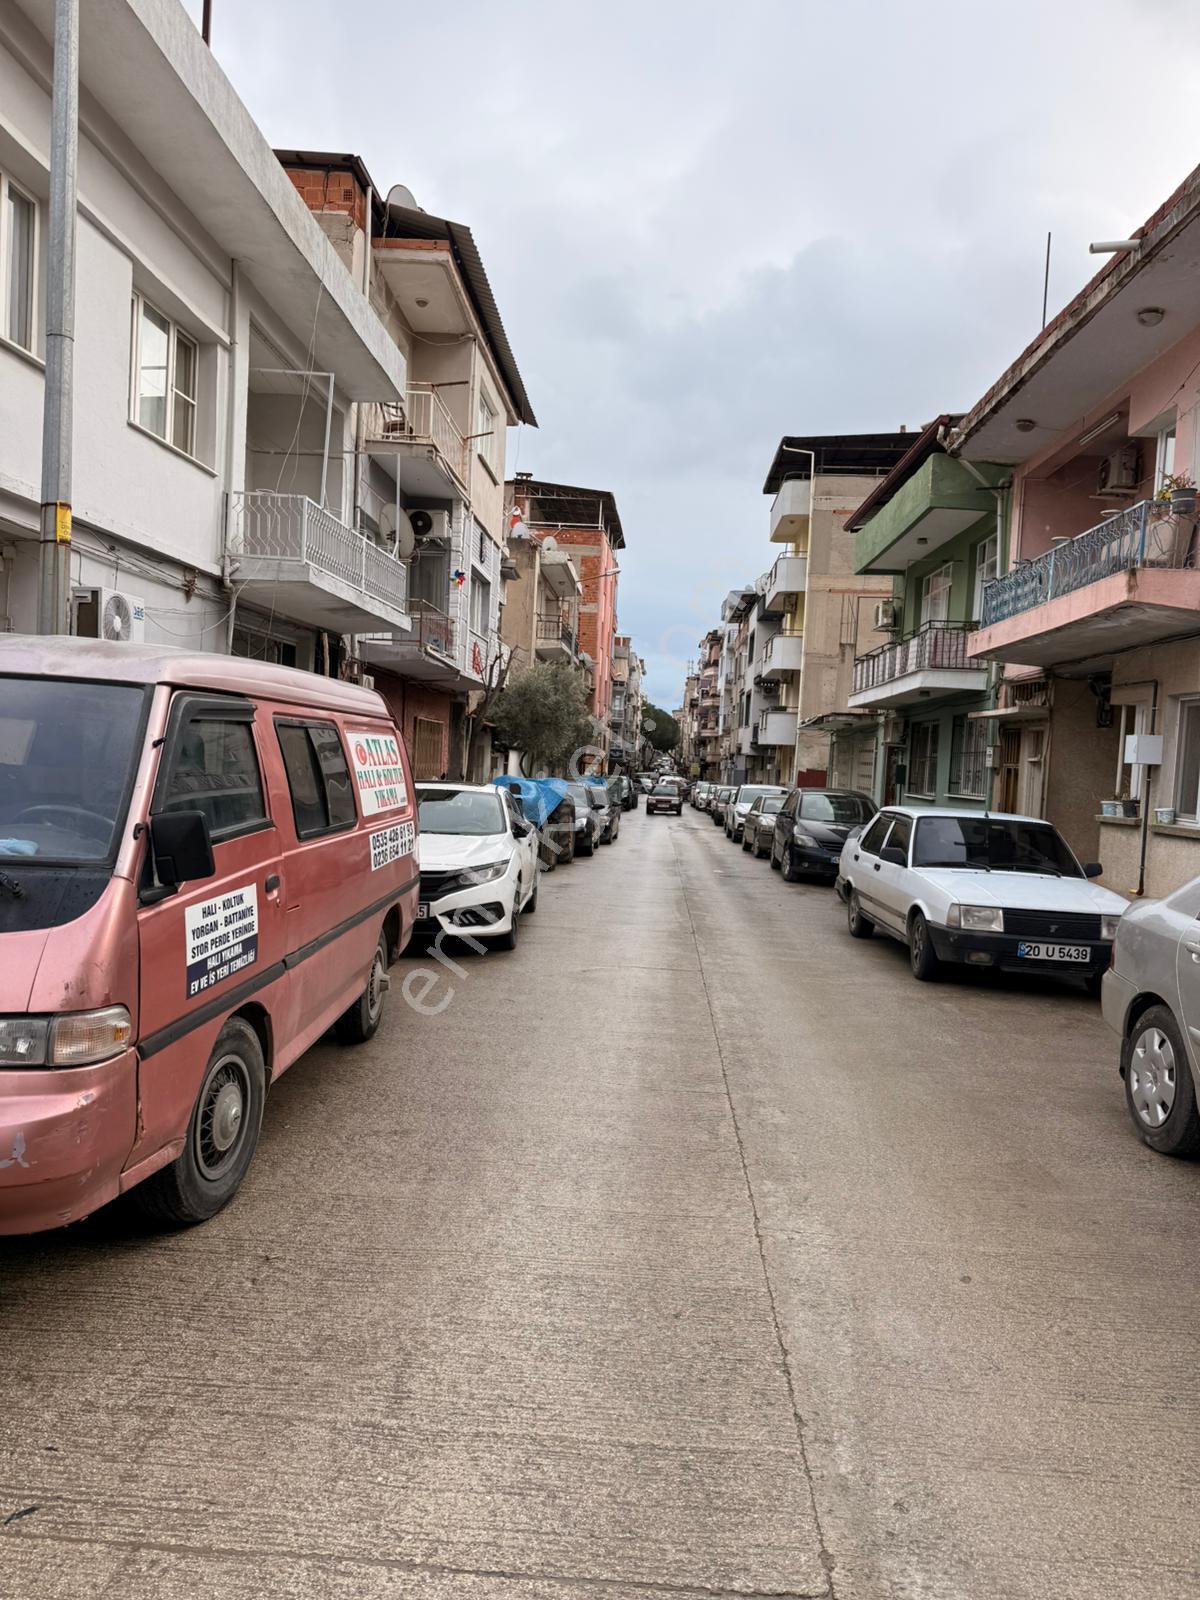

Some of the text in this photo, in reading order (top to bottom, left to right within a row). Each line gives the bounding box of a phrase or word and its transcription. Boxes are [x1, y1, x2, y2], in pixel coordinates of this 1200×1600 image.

[365, 738, 398, 766] ATLAS
[357, 770, 376, 789] HALI
[376, 769, 383, 786] &
[372, 832, 387, 850] 0535
[389, 827, 399, 843] 426
[400, 840, 406, 854] 11
[202, 903, 217, 919] HALI
[222, 894, 244, 910] KOLTUK
[191, 920, 218, 941] YORGAN
[224, 905, 254, 927] BATTANİYE
[191, 921, 255, 959] STOR PERDE YERİNDE
[207, 954, 221, 970] HALI
[1025, 945, 1040, 957] 20
[1046, 946, 1055, 957] U
[1058, 946, 1088, 960] 5439
[190, 980, 200, 995] EV
[200, 975, 208, 989] VE
[209, 970, 216, 984] İŞ
[217, 963, 229, 980] YERİ
